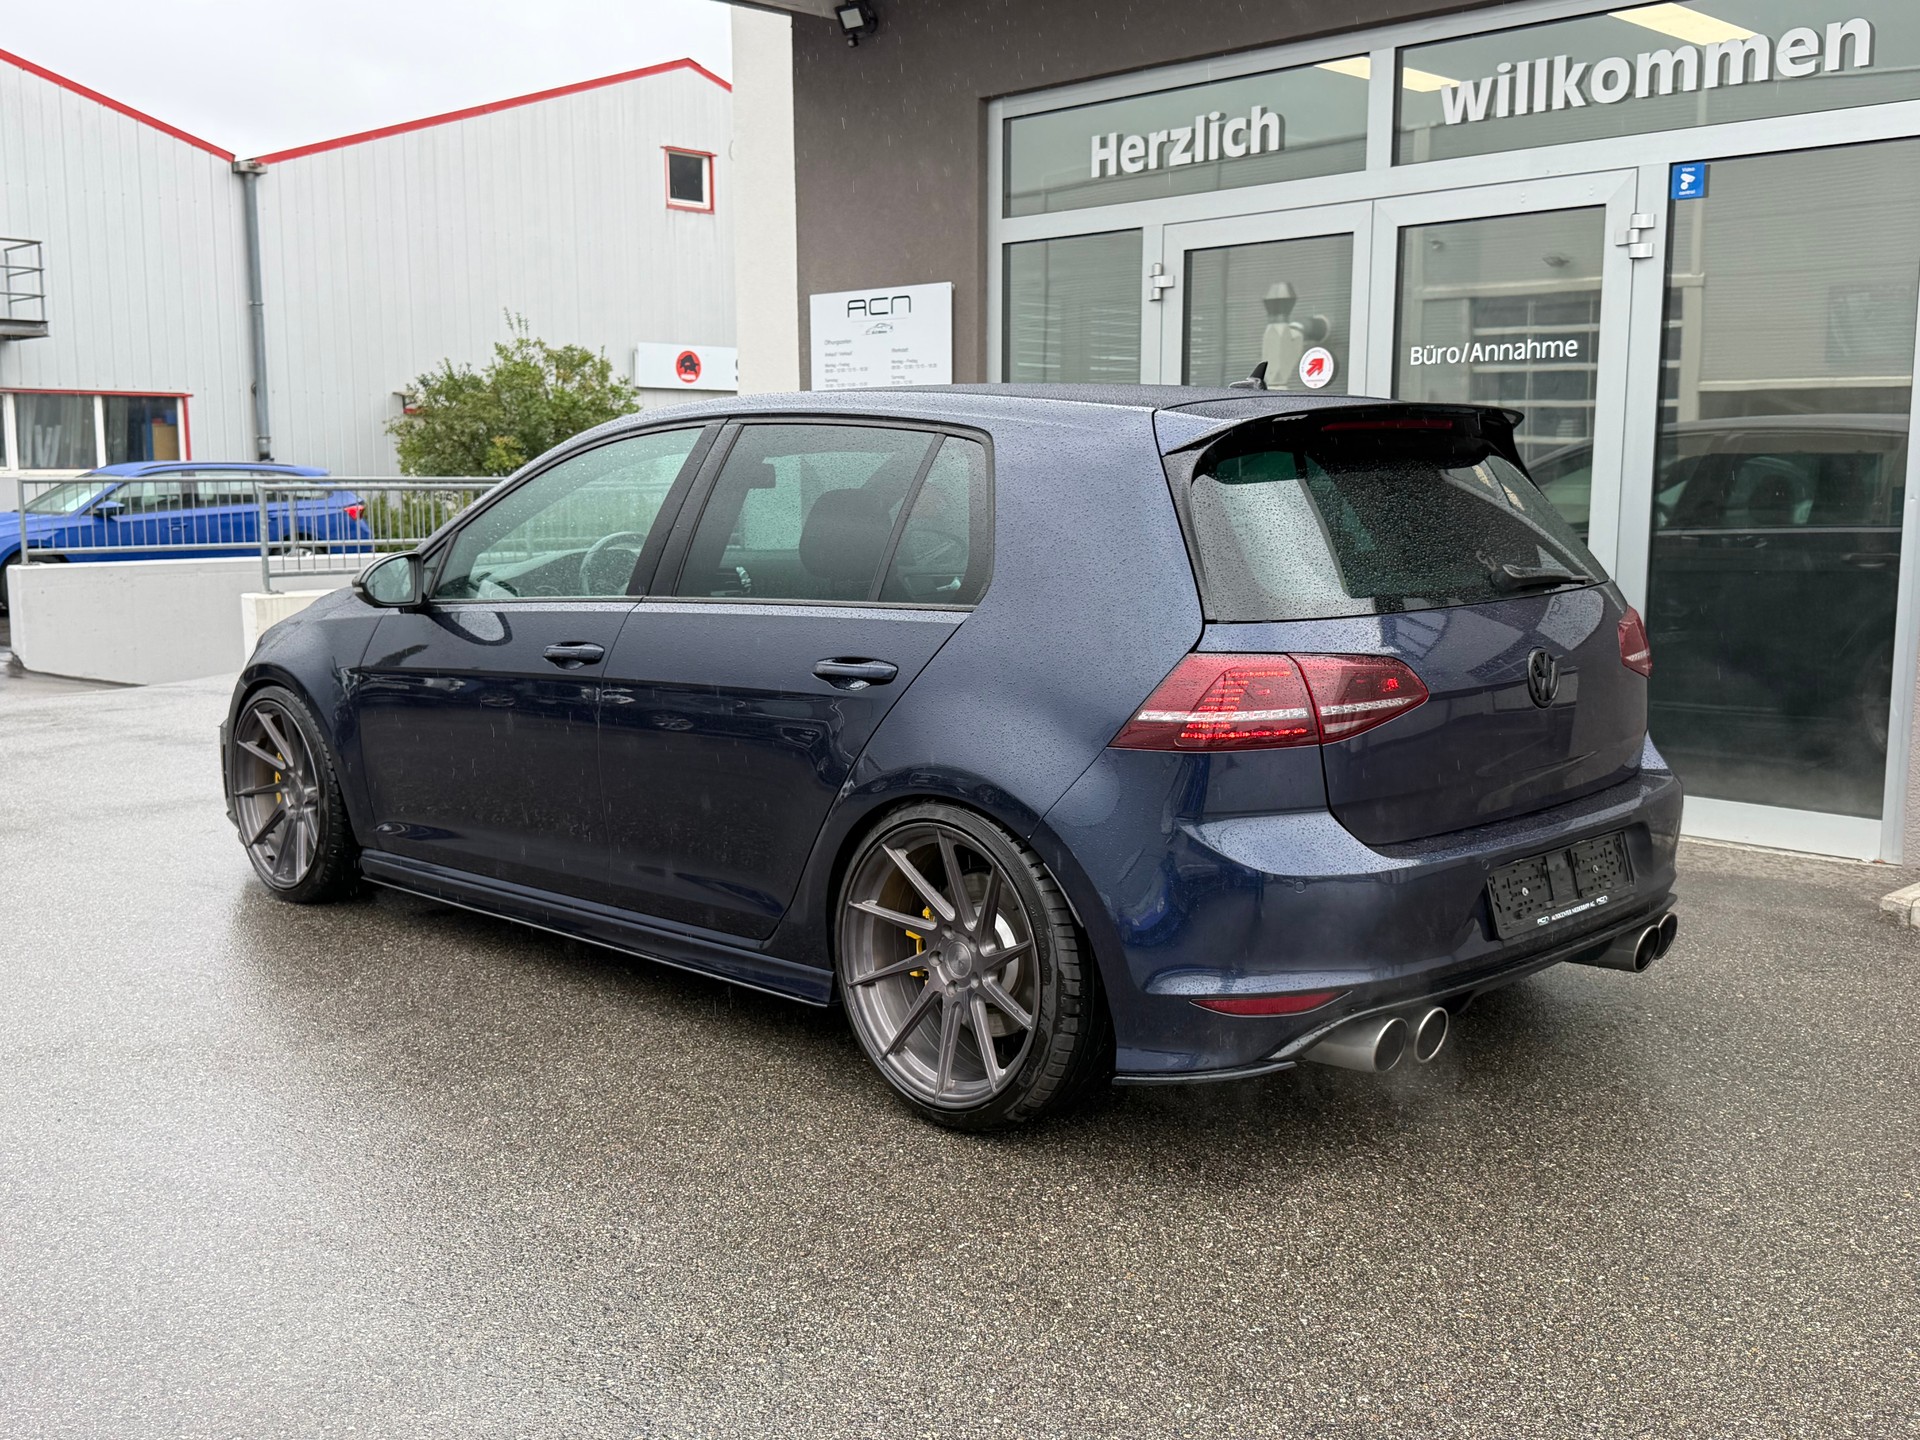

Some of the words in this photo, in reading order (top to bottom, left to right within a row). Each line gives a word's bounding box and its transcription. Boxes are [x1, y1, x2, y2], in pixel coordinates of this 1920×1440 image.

[1091, 105, 1280, 178] Herzlich
[1441, 17, 1870, 125] willkommen
[1410, 339, 1578, 366] Büro/Annahme
